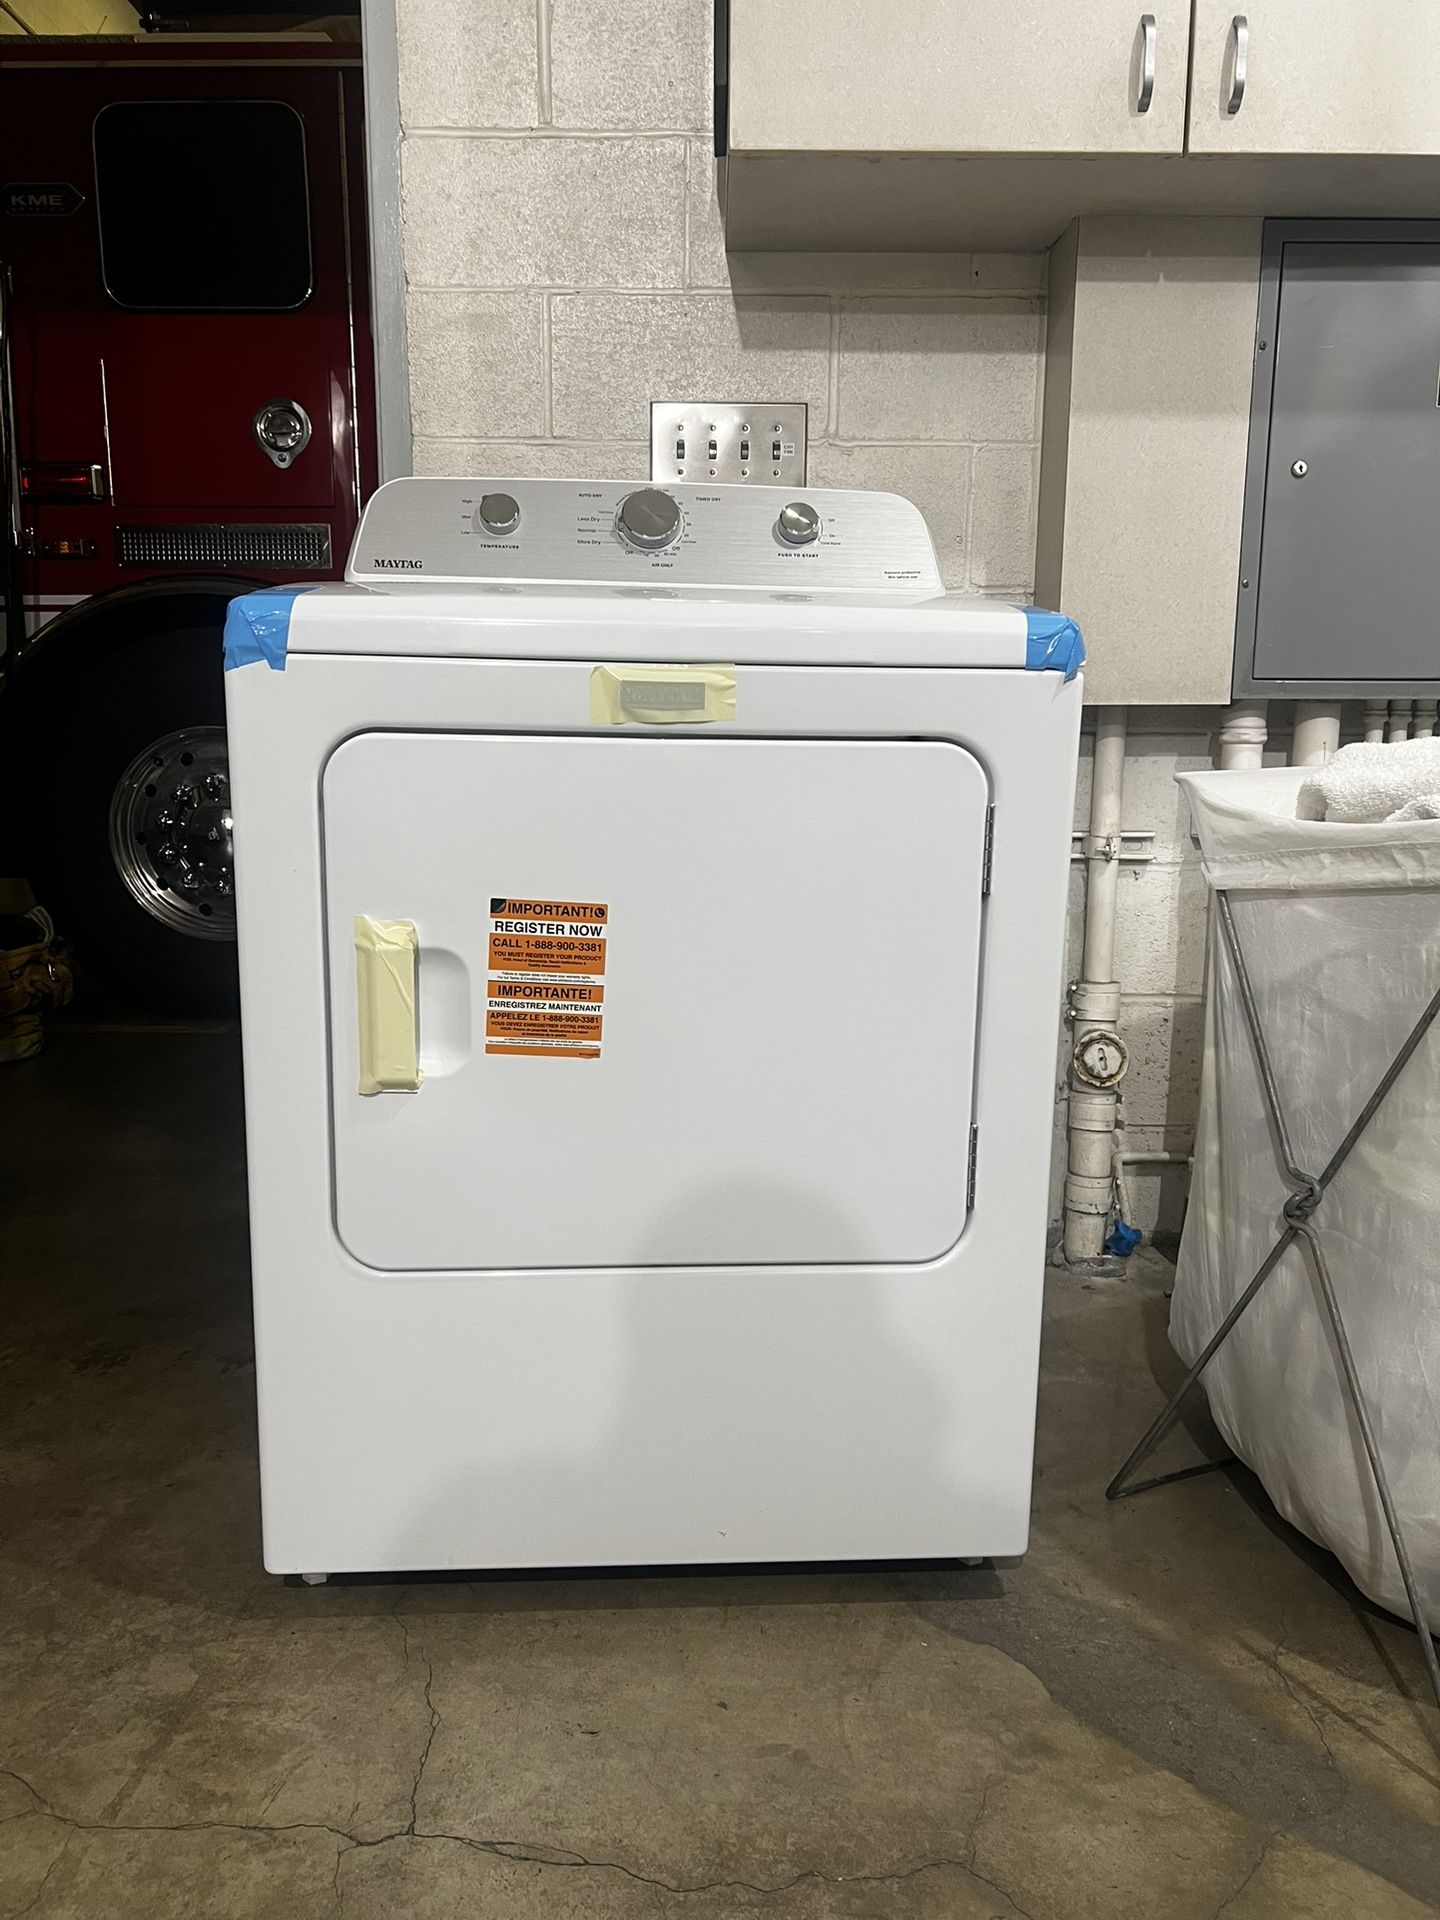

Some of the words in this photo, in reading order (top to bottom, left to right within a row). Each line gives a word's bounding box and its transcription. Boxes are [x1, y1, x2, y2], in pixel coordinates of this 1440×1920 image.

[11, 195, 63, 206] KME
[374, 559, 423, 569] MAYTAG
[508, 903, 593, 917] IMPORTANT!
[495, 921, 565, 935] REGISTER
[569, 925, 603, 936] NOW
[492, 938, 522, 948] CALL
[525, 940, 602, 952] 1-888-900-3381
[497, 985, 592, 999] IMPORTANTE!
[488, 1000, 547, 1010] ENREGISTREZ
[548, 1004, 602, 1012] MAINTENANT
[490, 1012, 528, 1020] APPELEZ
[542, 1014, 599, 1023] 1-888-900-3381
